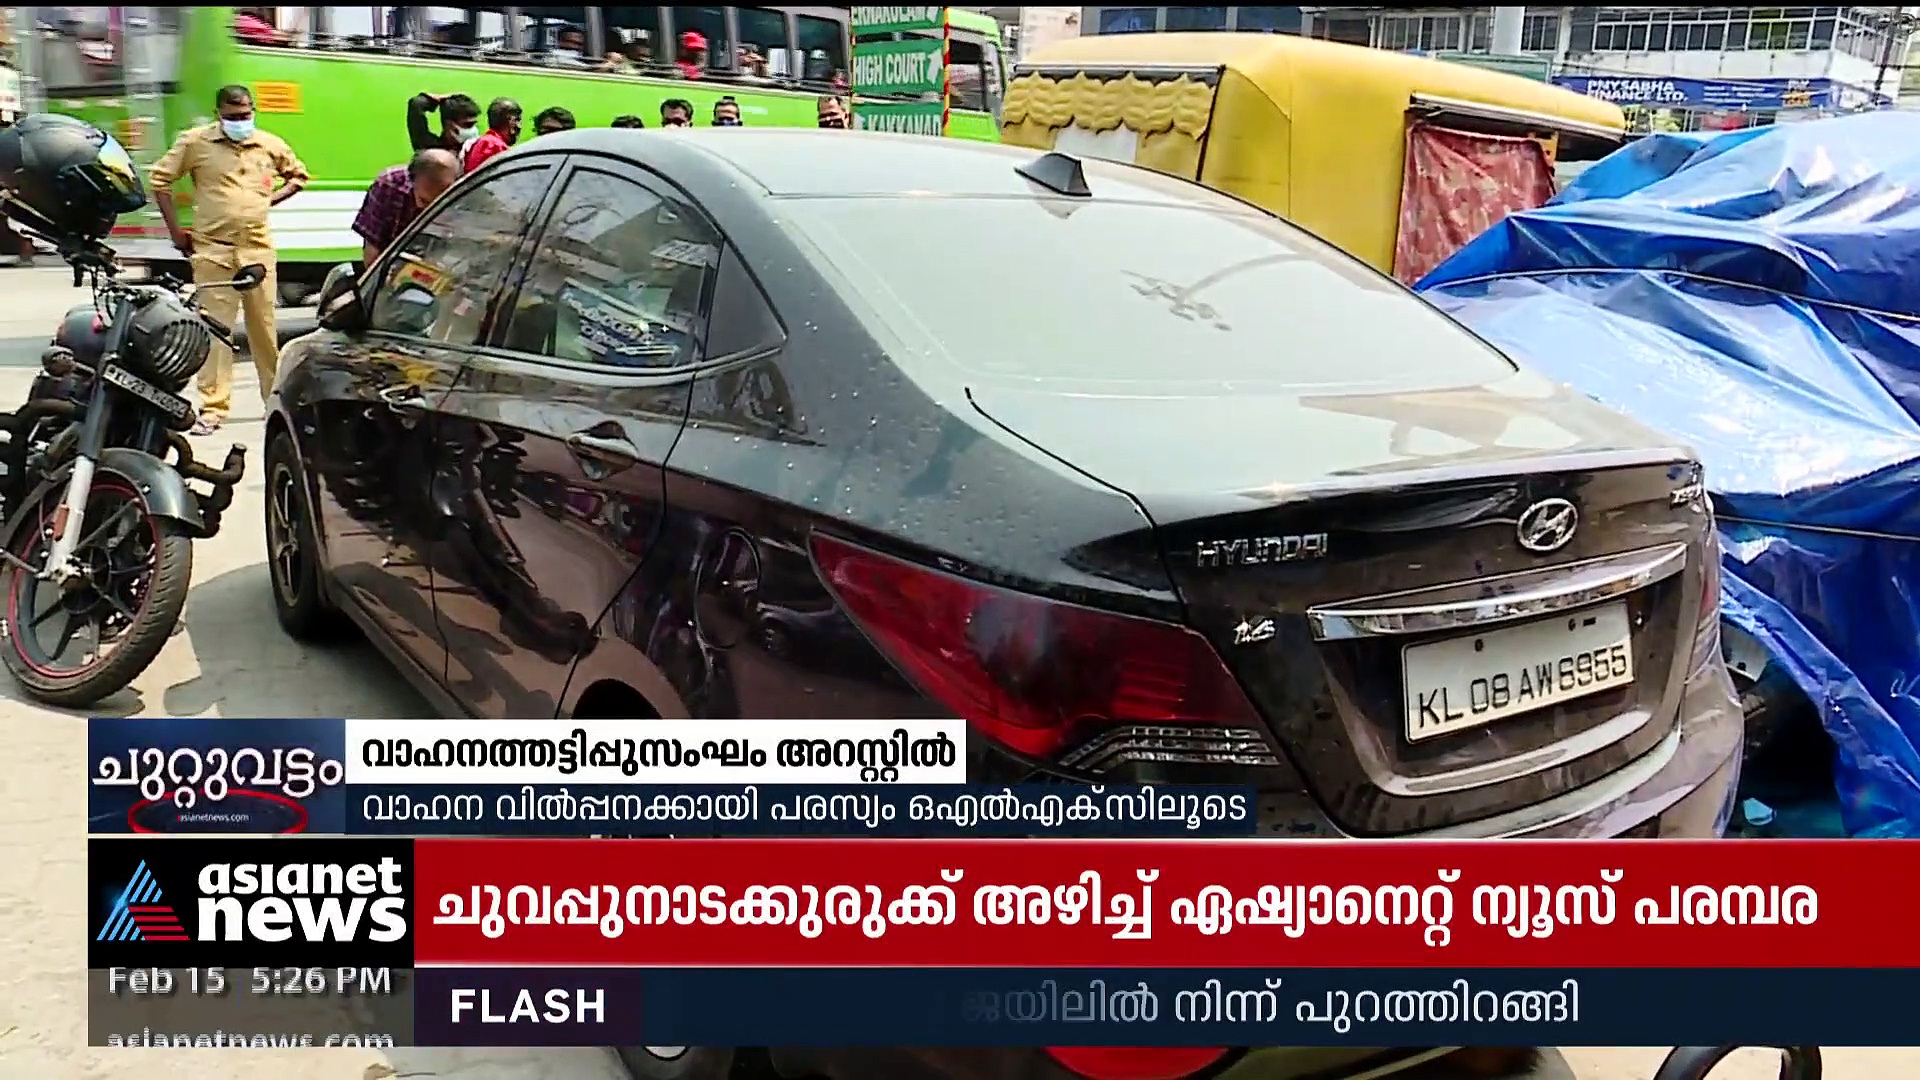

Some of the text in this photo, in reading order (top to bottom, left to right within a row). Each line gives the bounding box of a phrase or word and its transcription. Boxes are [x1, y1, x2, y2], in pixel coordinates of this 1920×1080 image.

[853, 52, 926, 86] HIGH COURT
[1197, 532, 1329, 567] HYUNDAI
[1418, 644, 1628, 729] KL 08 AW 6955
